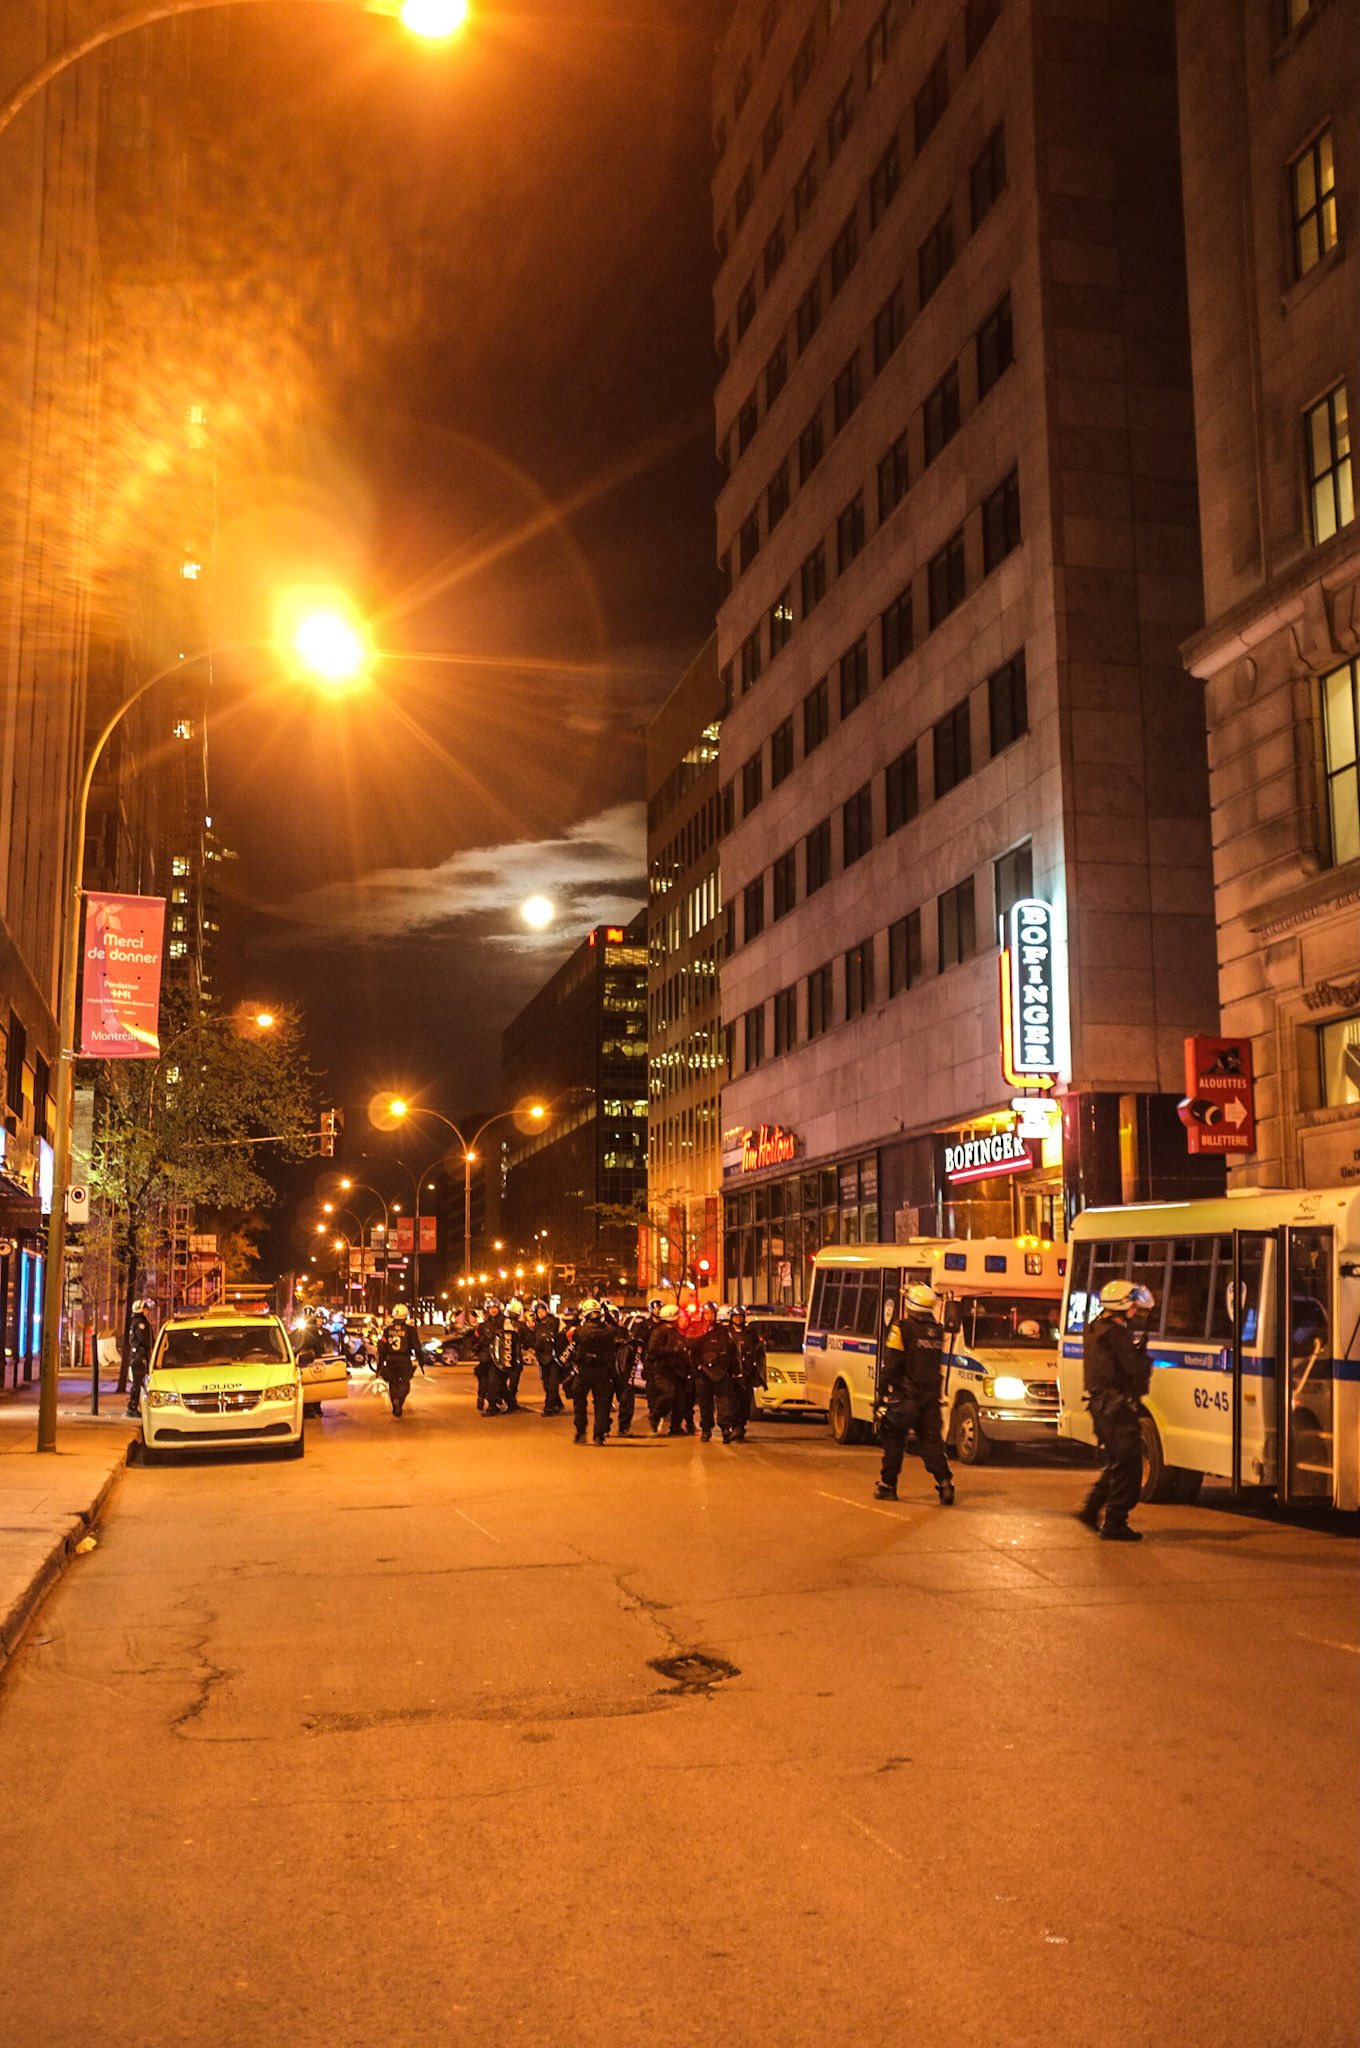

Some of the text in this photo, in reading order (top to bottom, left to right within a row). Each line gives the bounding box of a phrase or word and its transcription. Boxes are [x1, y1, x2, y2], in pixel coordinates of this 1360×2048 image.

[103, 933, 144, 949] Merci
[87, 947, 158, 964] de donner
[1021, 906, 1051, 1065] BOFINGER
[1198, 1077, 1248, 1089] ALOUETTES
[741, 1129, 757, 1174] Tim
[757, 1124, 794, 1168] Hortons
[944, 1132, 1025, 1173] BOFINGER
[1201, 1134, 1249, 1147] BILLETTERIE
[504, 1332, 513, 1368] POLICE
[1194, 1387, 1230, 1412] 62-45
